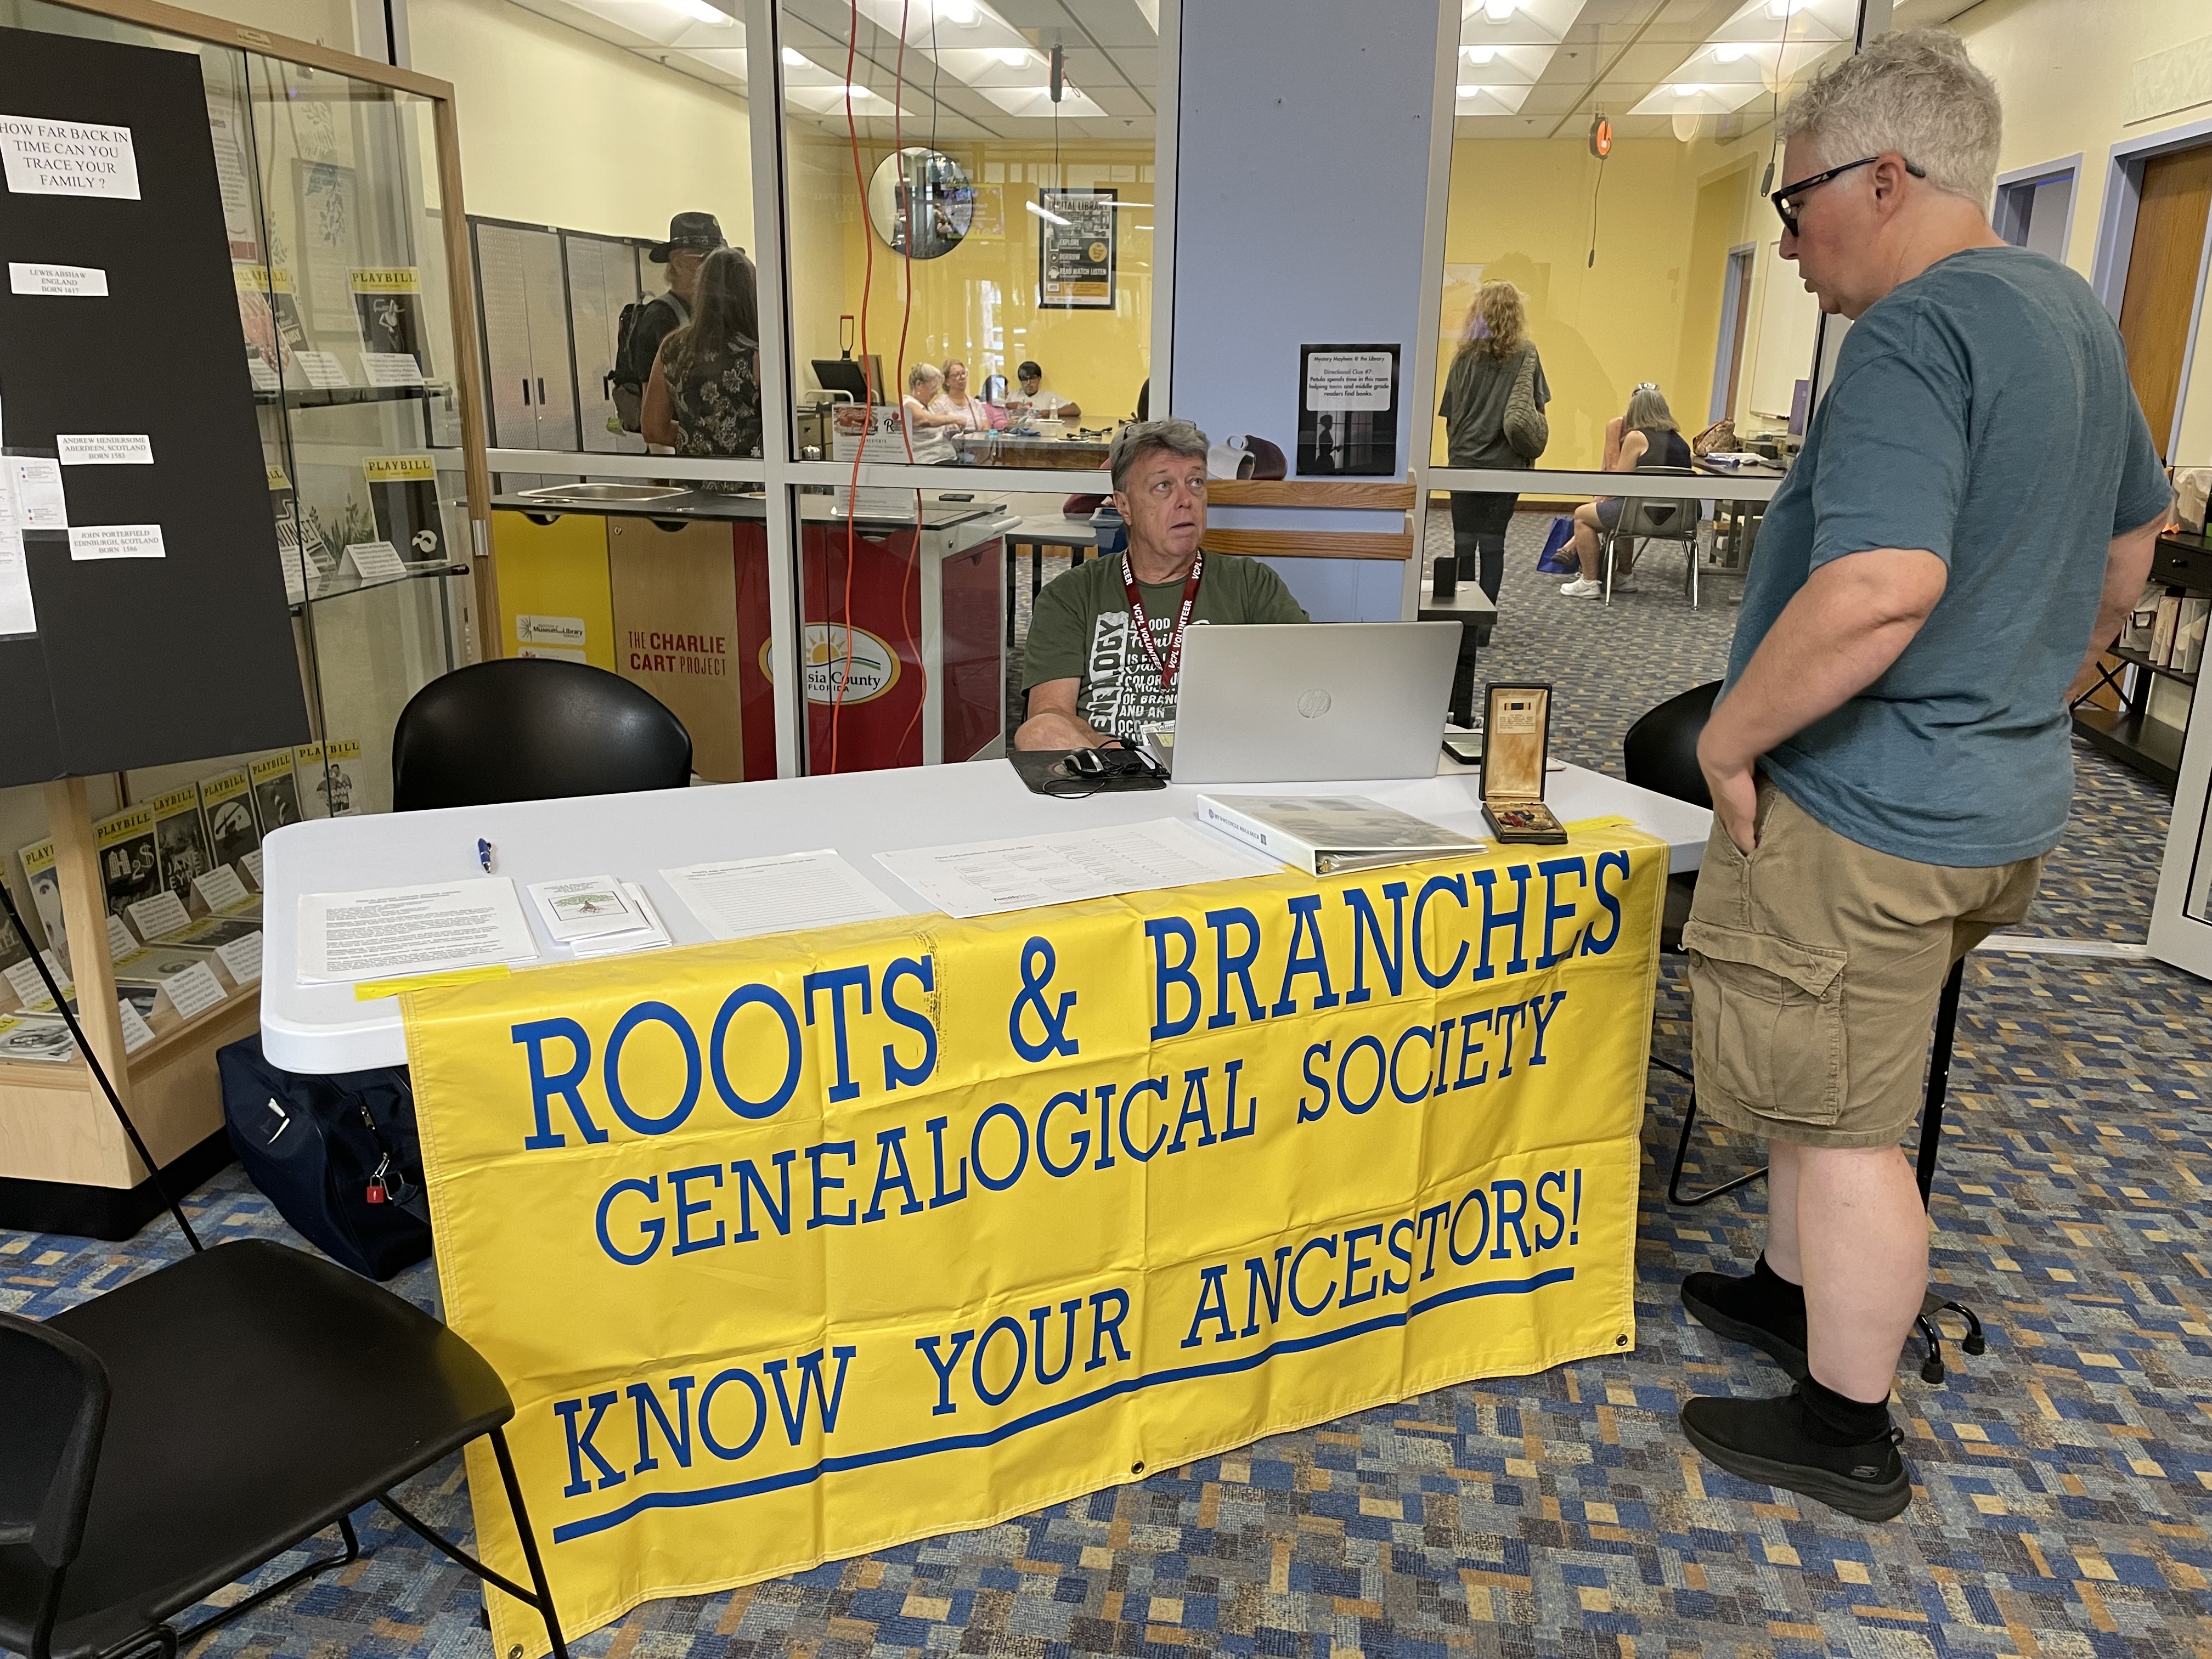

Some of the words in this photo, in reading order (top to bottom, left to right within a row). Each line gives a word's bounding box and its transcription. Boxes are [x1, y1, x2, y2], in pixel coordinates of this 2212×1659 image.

[0, 122, 32, 136] HOW
[38, 126, 67, 138] FAR
[70, 128, 111, 142] BACK
[114, 132, 128, 143] IN
[13, 140, 51, 154] TIME
[54, 143, 84, 155] CAN
[88, 145, 119, 158] YOU
[23, 157, 72, 171] TRACE
[75, 160, 116, 173] YOUR
[40, 174, 95, 188] FAMILY
[99, 178, 105, 189] ?
[41, 278, 77, 286] ENGLAND
[352, 272, 417, 283] PLAYBILL
[369, 460, 431, 472] PLAYBILL
[101, 530, 150, 538] PORTERFIELD
[1191, 561, 1203, 580] VCPL
[1132, 603, 1146, 627] VCPL
[533, 625, 558, 634] Museum
[562, 628, 583, 636] Library
[628, 631, 647, 650] THE
[650, 633, 726, 654] CHARLIE
[630, 653, 675, 673] CART
[680, 657, 726, 676] PROJECT
[1127, 653, 1139, 665] IS
[1168, 650, 1180, 669] VCPL
[831, 671, 881, 691] County
[1119, 705, 1144, 717] AND
[1147, 706, 1165, 718] AN
[252, 755, 290, 775] PLAYBILL
[204, 774, 245, 797] PLAYBILL
[98, 812, 151, 838] PLAYBILL
[1227, 820, 1239, 830] UNCLE
[1250, 831, 1260, 839] DUCK
[167, 851, 200, 876] JANE
[512, 957, 936, 1149] ROOTS
[1011, 939, 1077, 1062] &
[1146, 851, 1628, 1040] BRANCHES
[597, 1060, 1255, 1265] GENEALOGICAL
[1299, 992, 1565, 1122] SOCIETY
[555, 1347, 855, 1497] KNOW
[917, 1289, 1130, 1414] YOUR
[1182, 1170, 1580, 1347] ANCESTORS!
